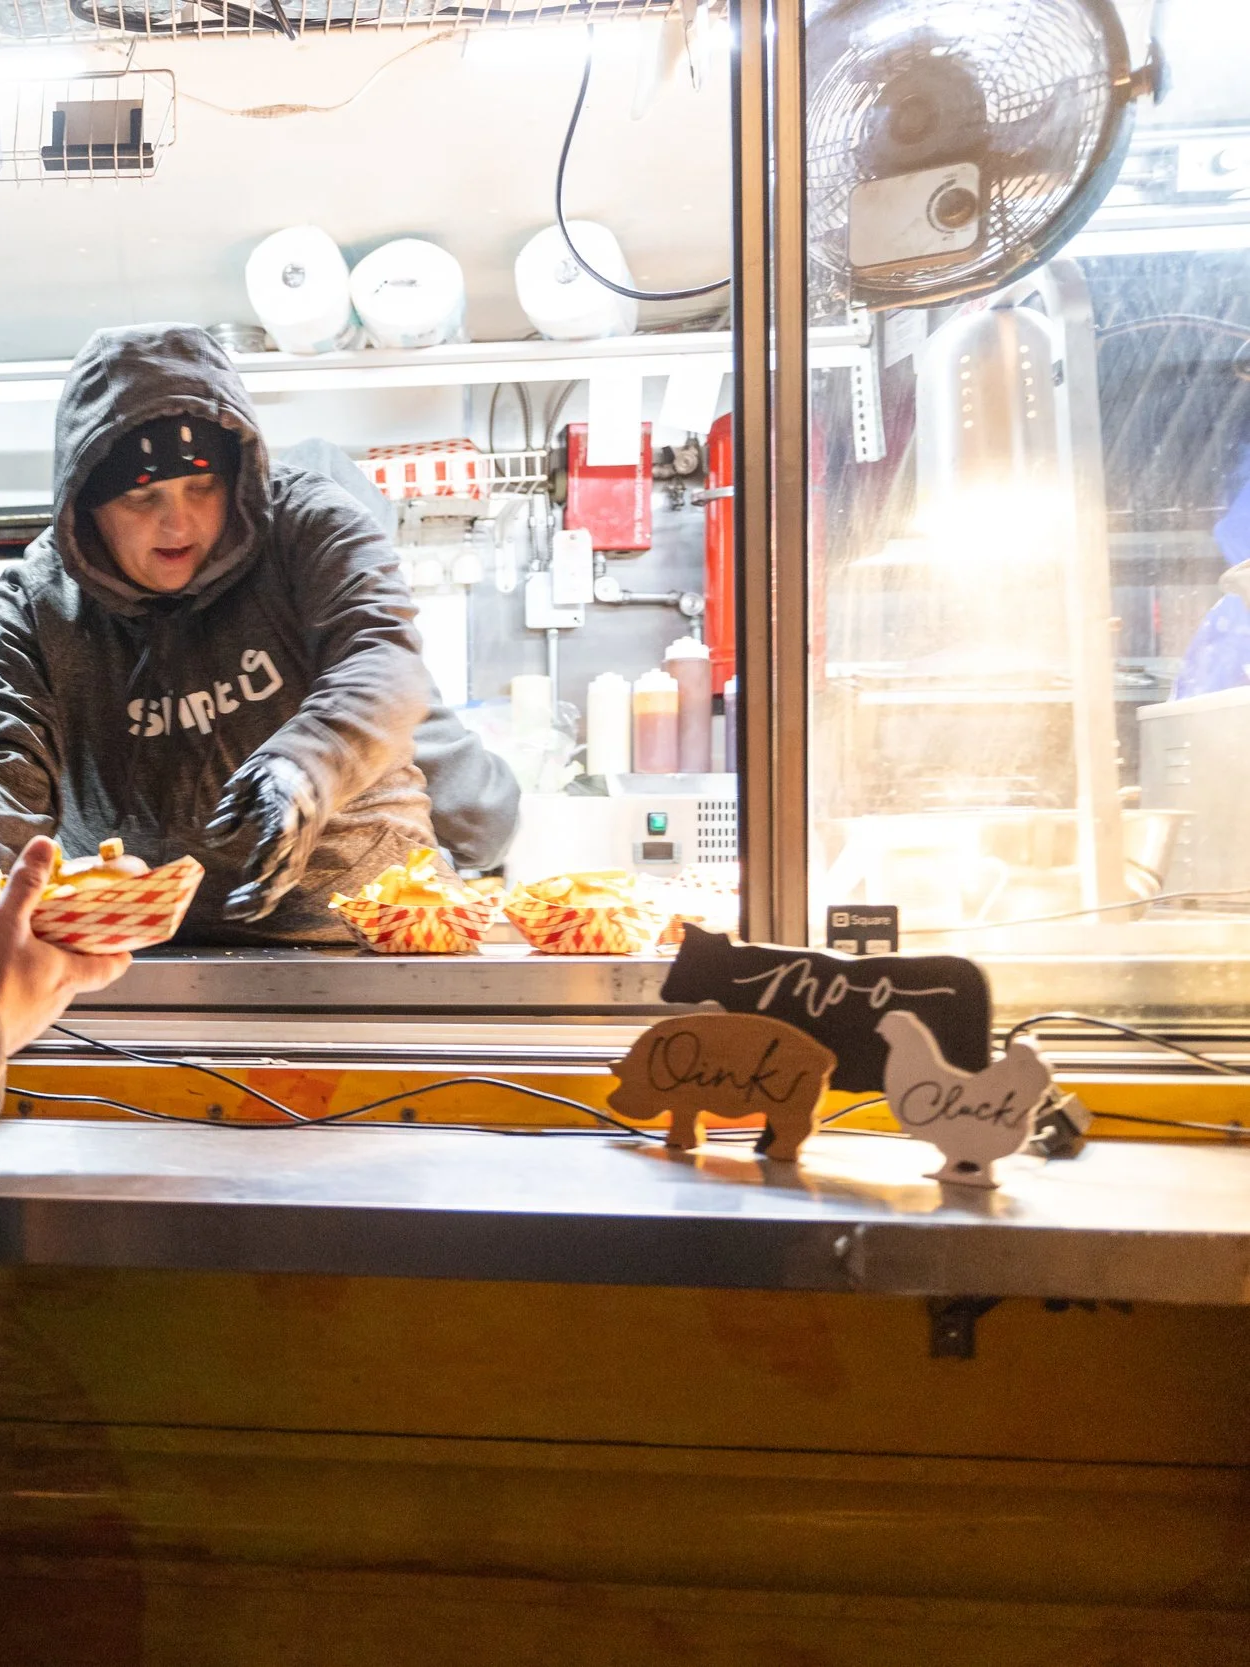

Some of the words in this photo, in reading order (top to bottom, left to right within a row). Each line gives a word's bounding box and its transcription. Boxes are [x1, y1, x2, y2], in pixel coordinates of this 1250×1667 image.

[850, 914, 892, 927] Square
[733, 958, 955, 1017] Moo
[648, 1031, 809, 1102] Oink
